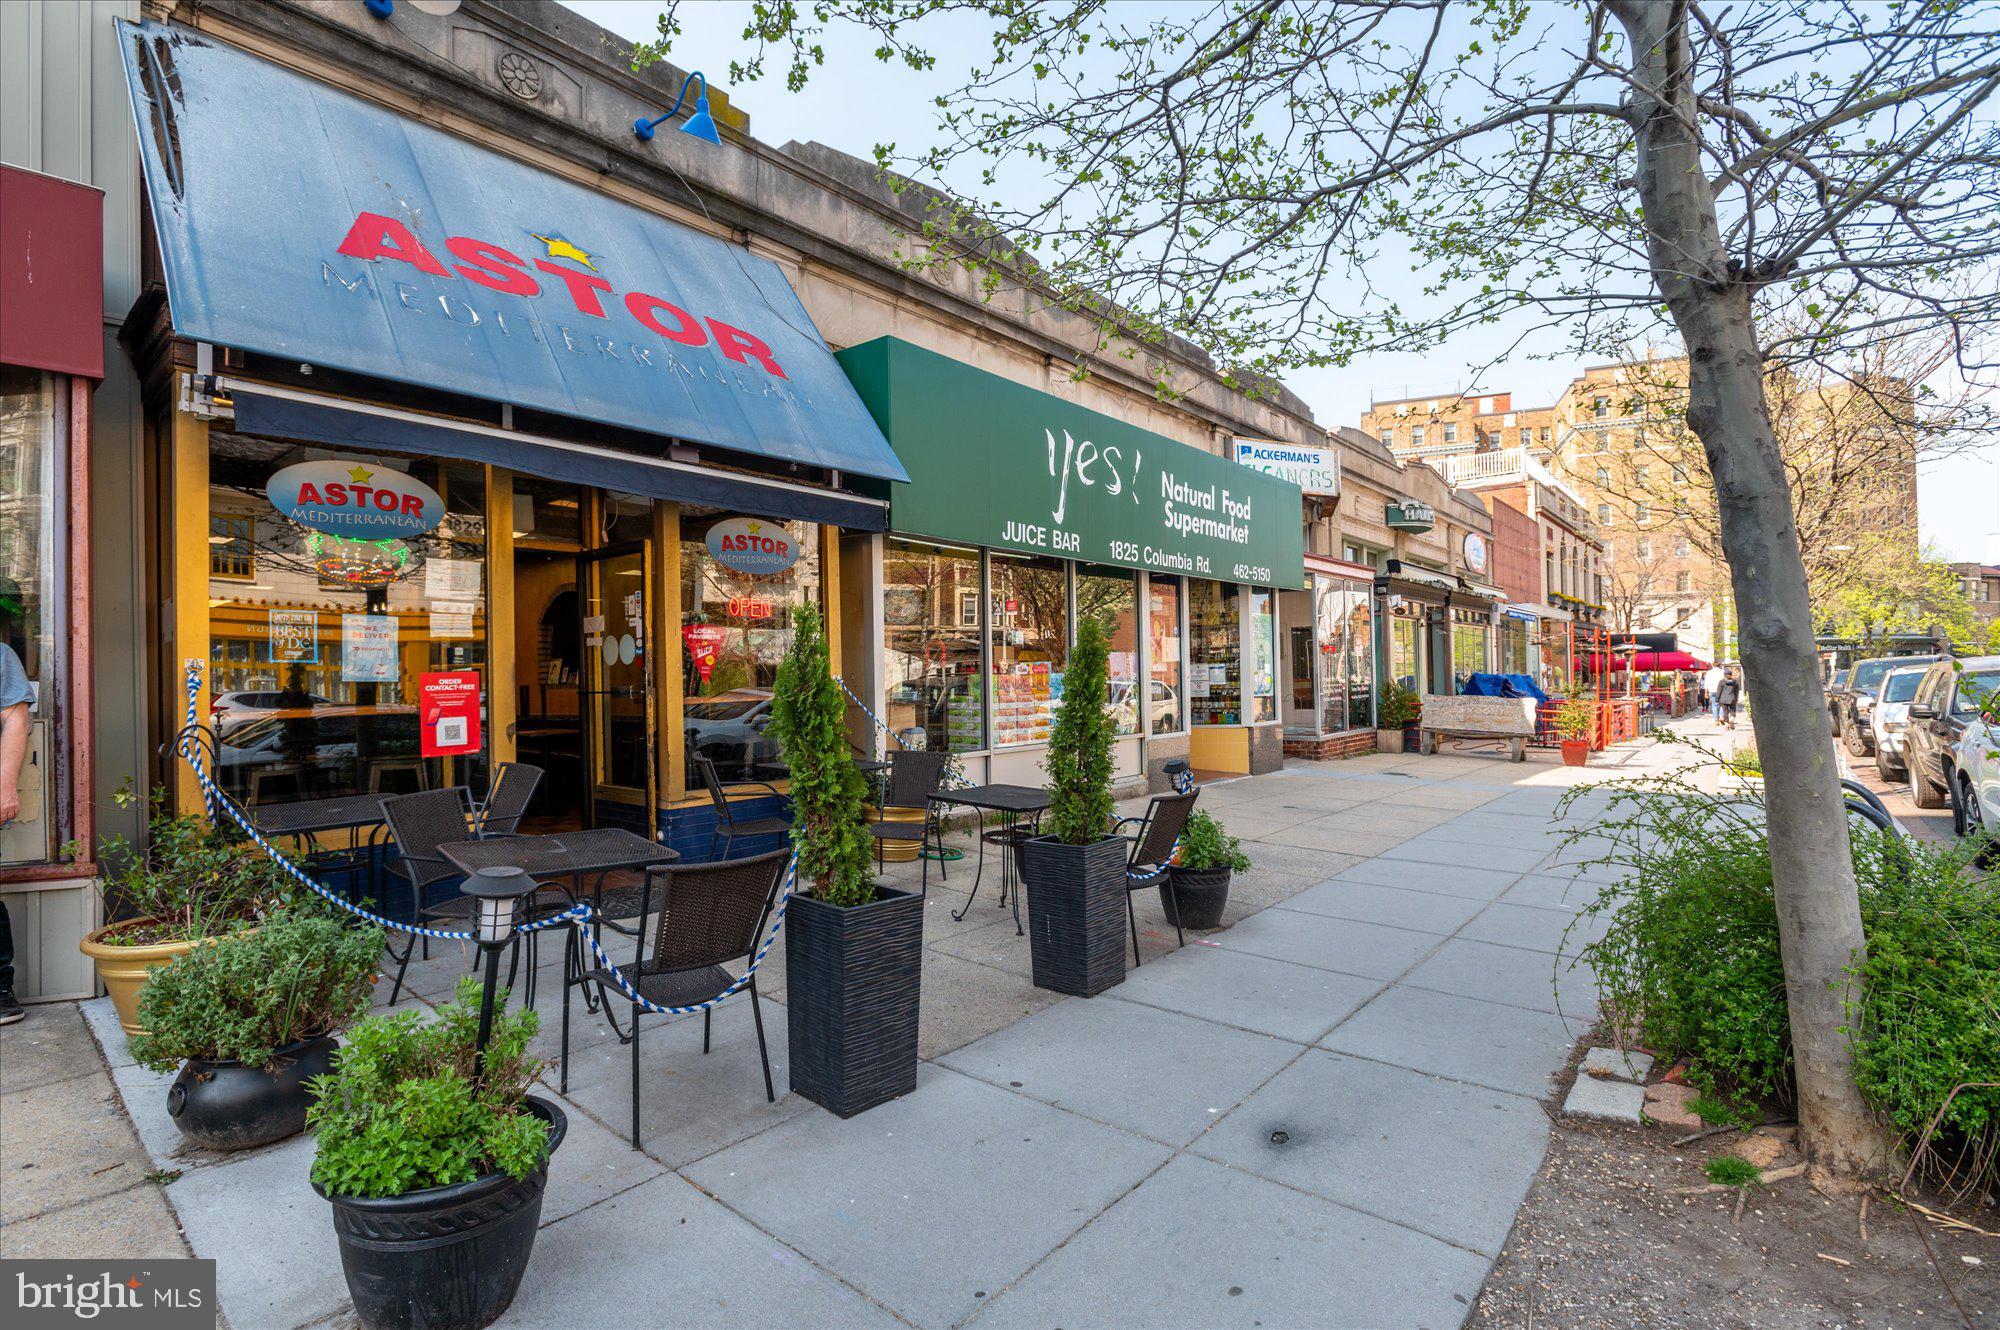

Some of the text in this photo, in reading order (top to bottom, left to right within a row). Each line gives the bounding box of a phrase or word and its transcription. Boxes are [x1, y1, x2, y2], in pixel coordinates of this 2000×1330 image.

[337, 211, 790, 382] ASTOR
[1254, 449, 1320, 464] ACKERMAN'S
[297, 482, 425, 519] ASTOR
[1161, 471, 1251, 520] Natural Food
[291, 508, 427, 530] MEDITERRANEAN
[1164, 501, 1250, 545] Supermarket
[721, 534, 788, 558] ASTOR
[1002, 521, 1081, 553] JUICE BAR
[718, 553, 790, 566] MEDITERRANEAN
[1109, 540, 1212, 574] 1825 Columbia Rd.
[1233, 563, 1271, 582] 462-5150
[728, 597, 773, 618] OPEN
[274, 624, 313, 638] BEST
